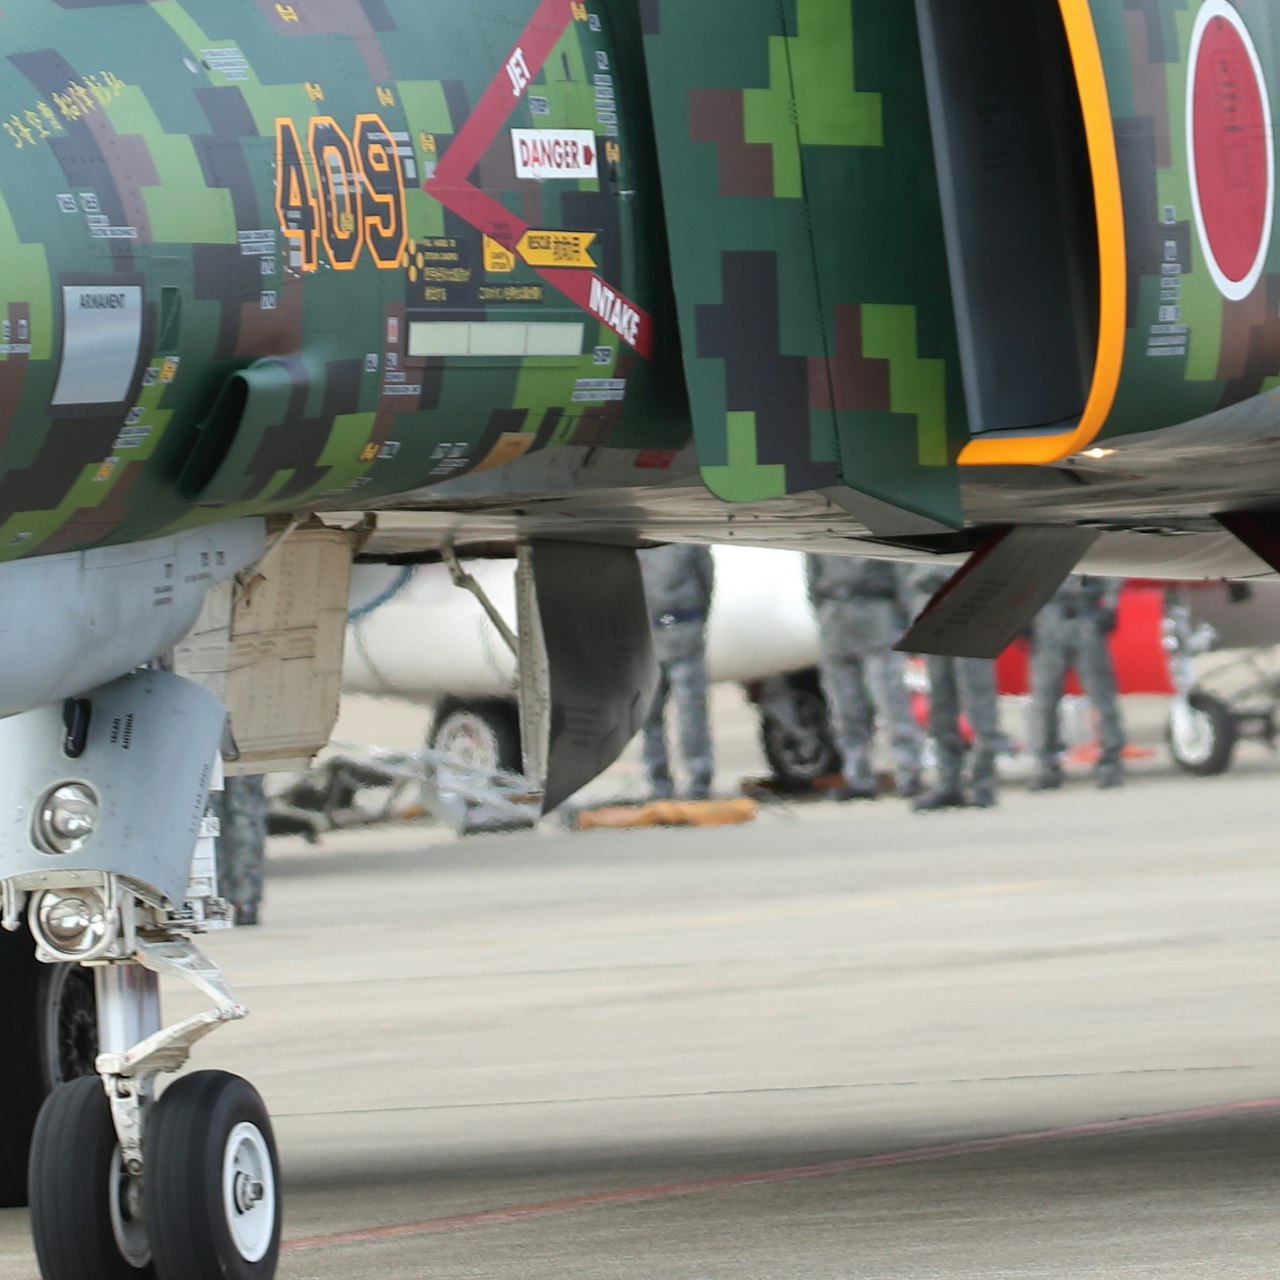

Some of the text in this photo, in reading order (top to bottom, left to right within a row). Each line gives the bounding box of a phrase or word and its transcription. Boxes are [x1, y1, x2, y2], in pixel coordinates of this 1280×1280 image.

[505, 47, 531, 97] JET
[519, 138, 581, 170] DANGER
[275, 113, 408, 272] 409
[79, 292, 126, 310] ARMAMENT
[589, 276, 641, 346] INTAKE
